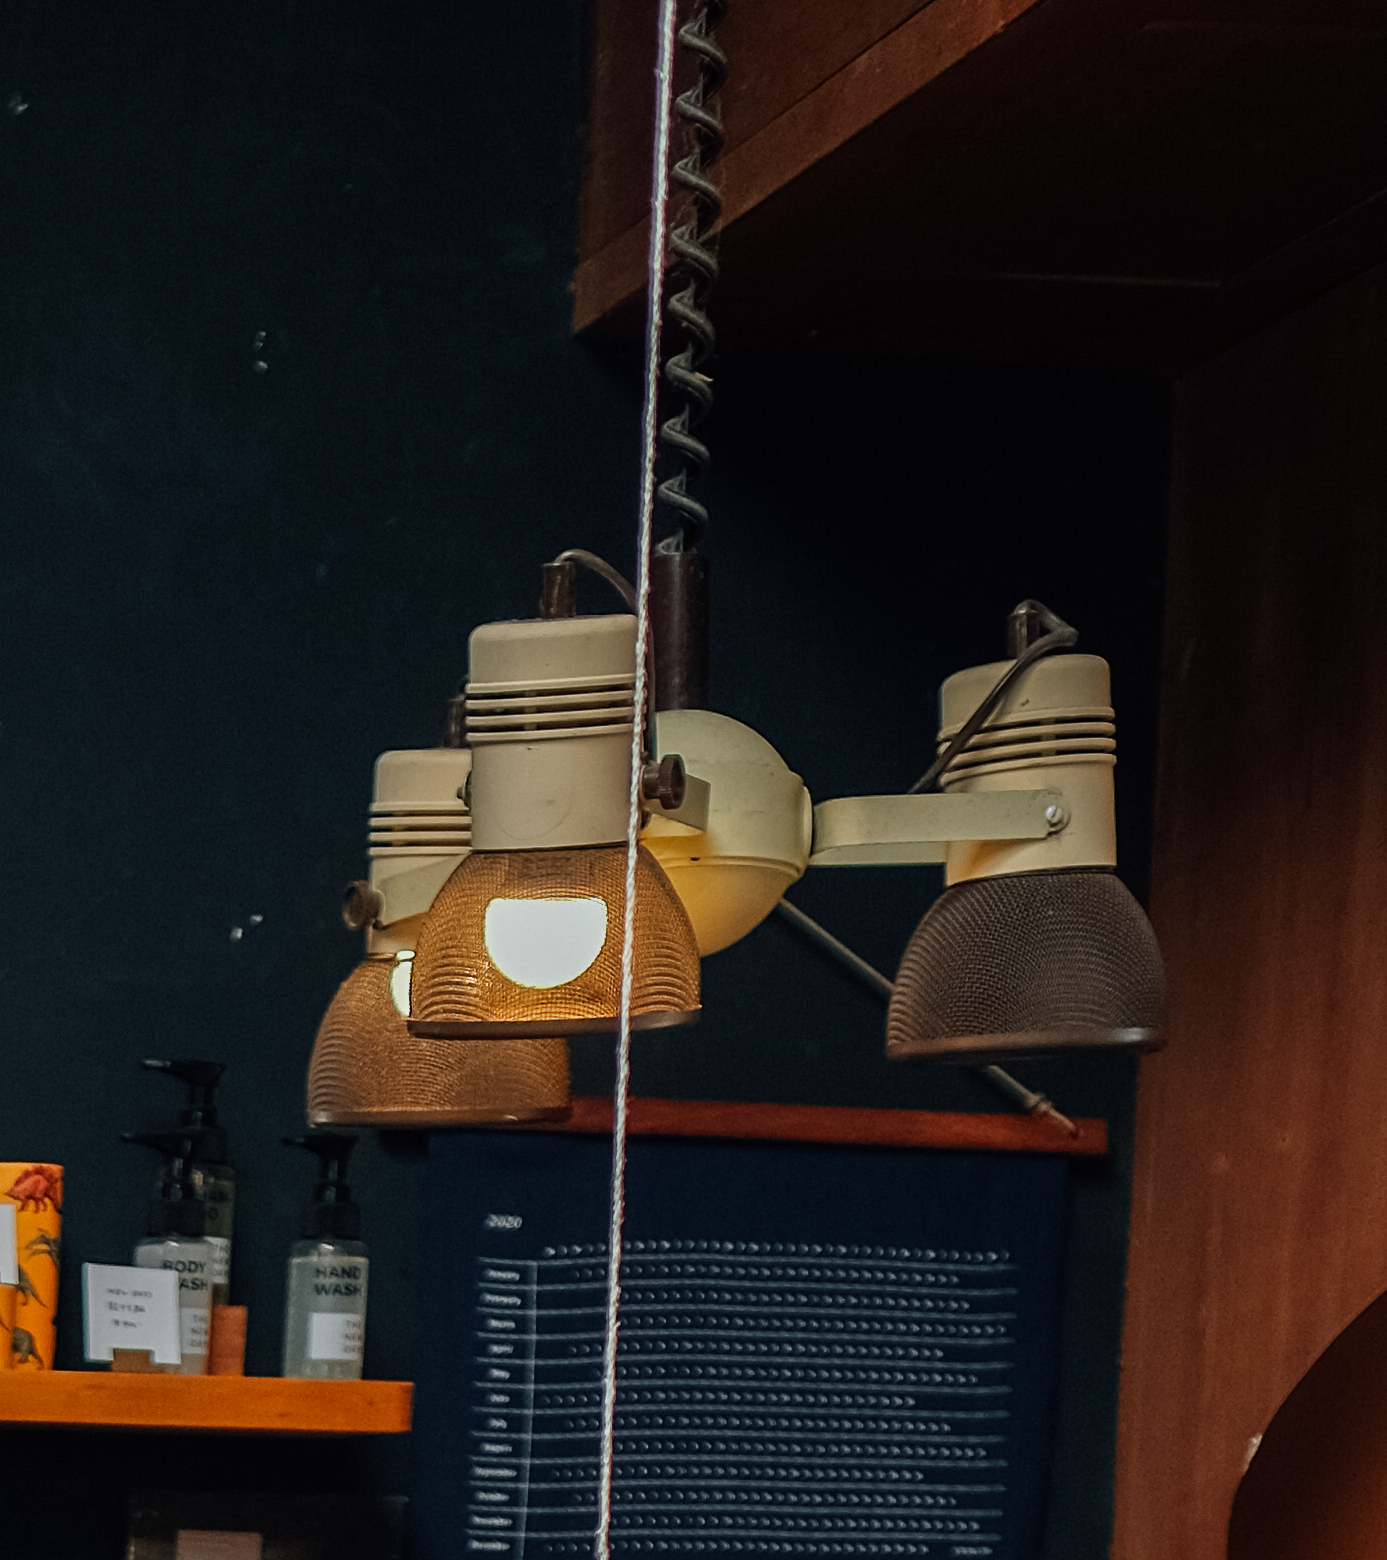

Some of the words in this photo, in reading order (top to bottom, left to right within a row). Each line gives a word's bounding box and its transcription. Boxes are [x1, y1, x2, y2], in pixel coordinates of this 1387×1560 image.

[163, 1259, 207, 1274] BODY
[315, 1266, 362, 1281] HAND
[314, 1283, 362, 1297] WASH
